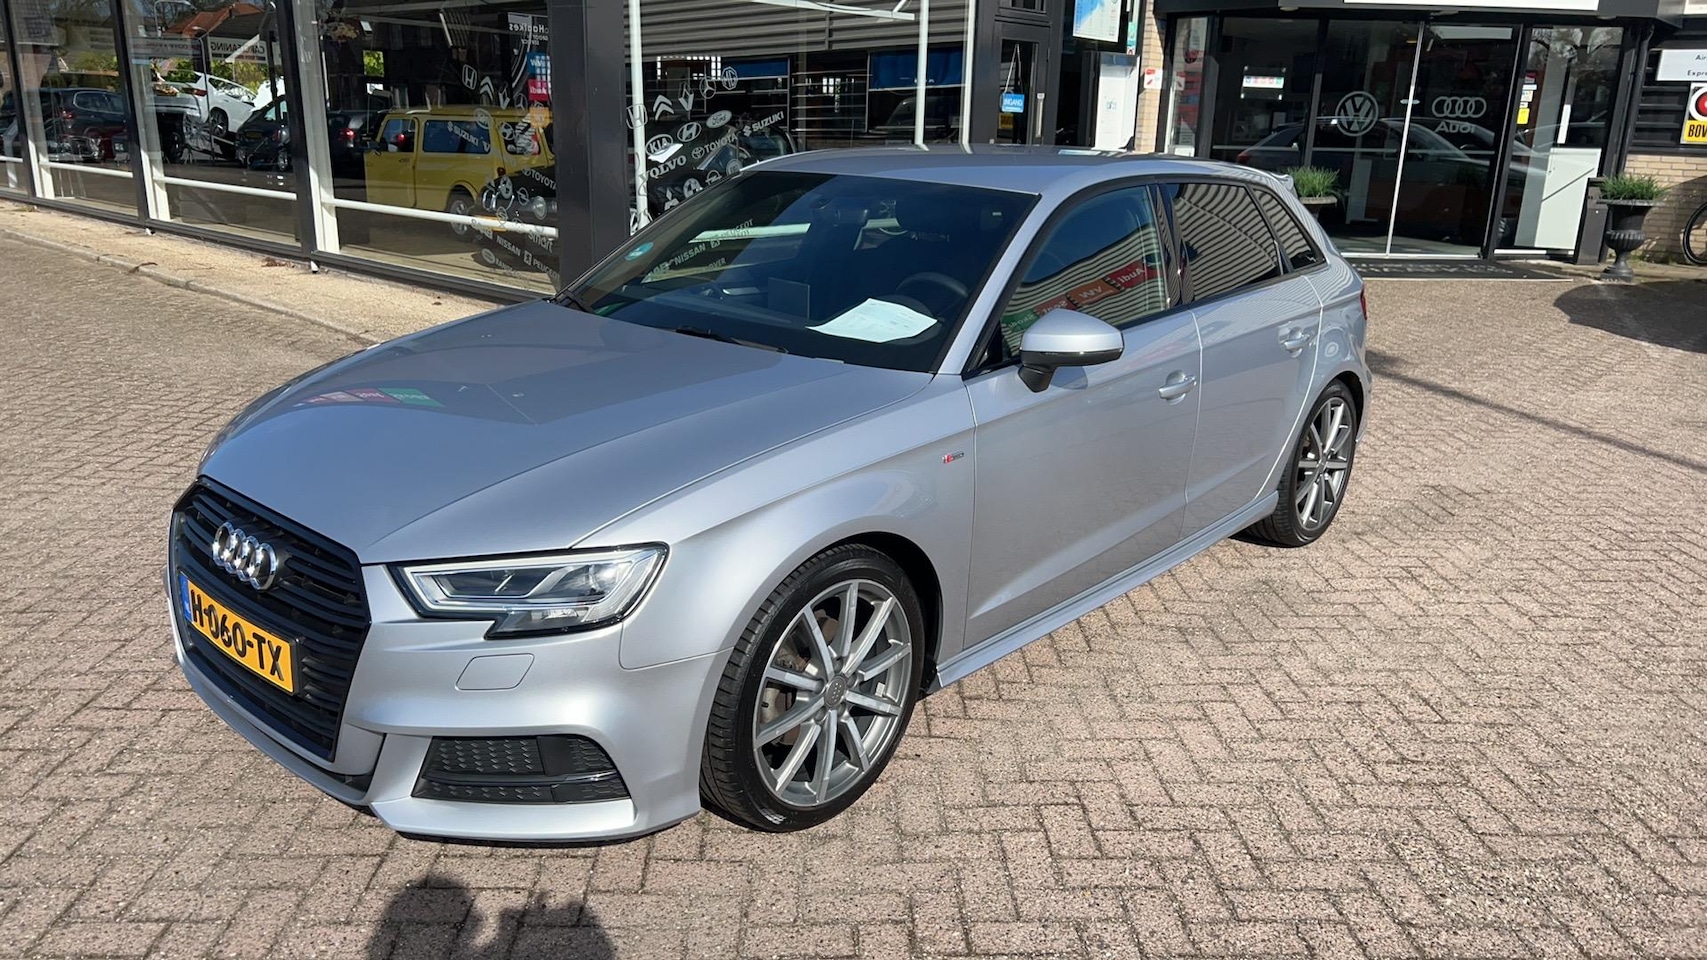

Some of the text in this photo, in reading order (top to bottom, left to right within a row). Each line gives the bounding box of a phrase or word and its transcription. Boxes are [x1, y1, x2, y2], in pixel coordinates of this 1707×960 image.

[751, 110, 785, 132] SUZUKI
[453, 126, 479, 146] SUZUKI
[650, 138, 668, 154] KIA
[705, 133, 738, 154] TOYOTA
[639, 154, 687, 180] VOLVO
[496, 235, 521, 257] NISSAN
[674, 243, 706, 265] NISSAN
[191, 589, 284, 682] H-060-TX
